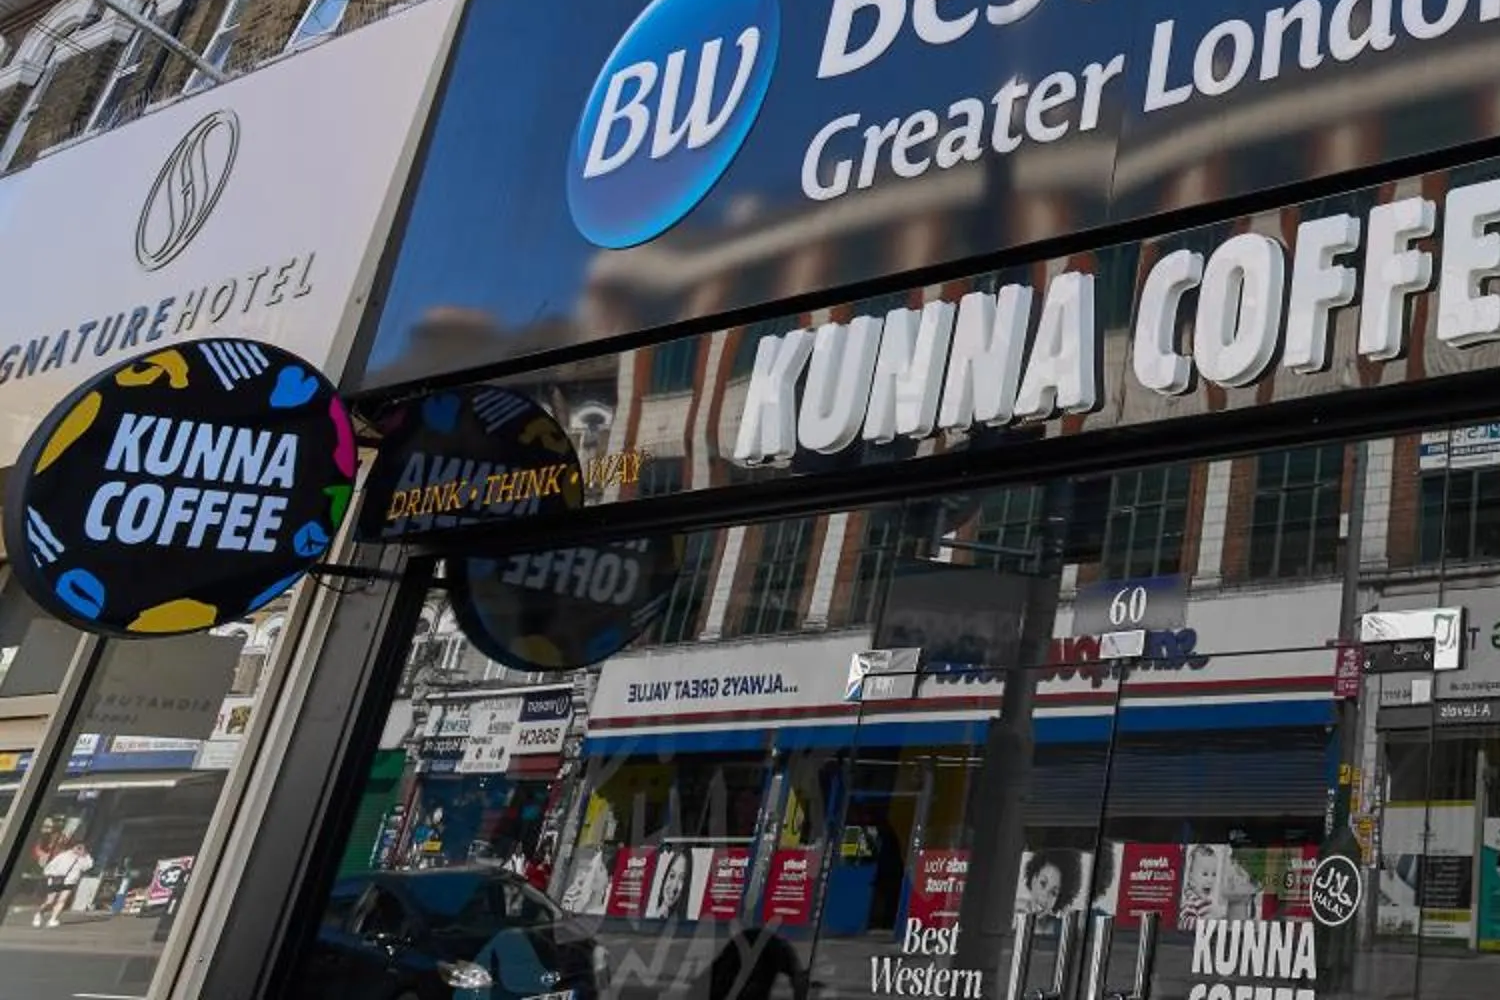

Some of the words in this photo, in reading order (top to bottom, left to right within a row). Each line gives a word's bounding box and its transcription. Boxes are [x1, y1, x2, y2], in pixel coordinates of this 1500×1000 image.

[584, 28, 760, 178] BW
[801, 54, 1125, 200] Greater
[733, 269, 1096, 467] KUNNA
[104, 413, 300, 489] KUNNA
[84, 481, 289, 553] COFFEE
[387, 480, 466, 521] DRINK
[484, 462, 567, 506] THINK
[1109, 585, 1147, 626] 60
[1312, 890, 1345, 918] HALAL
[902, 917, 961, 955] Best
[1191, 919, 1318, 980] KUNNA
[871, 955, 983, 999] Western
